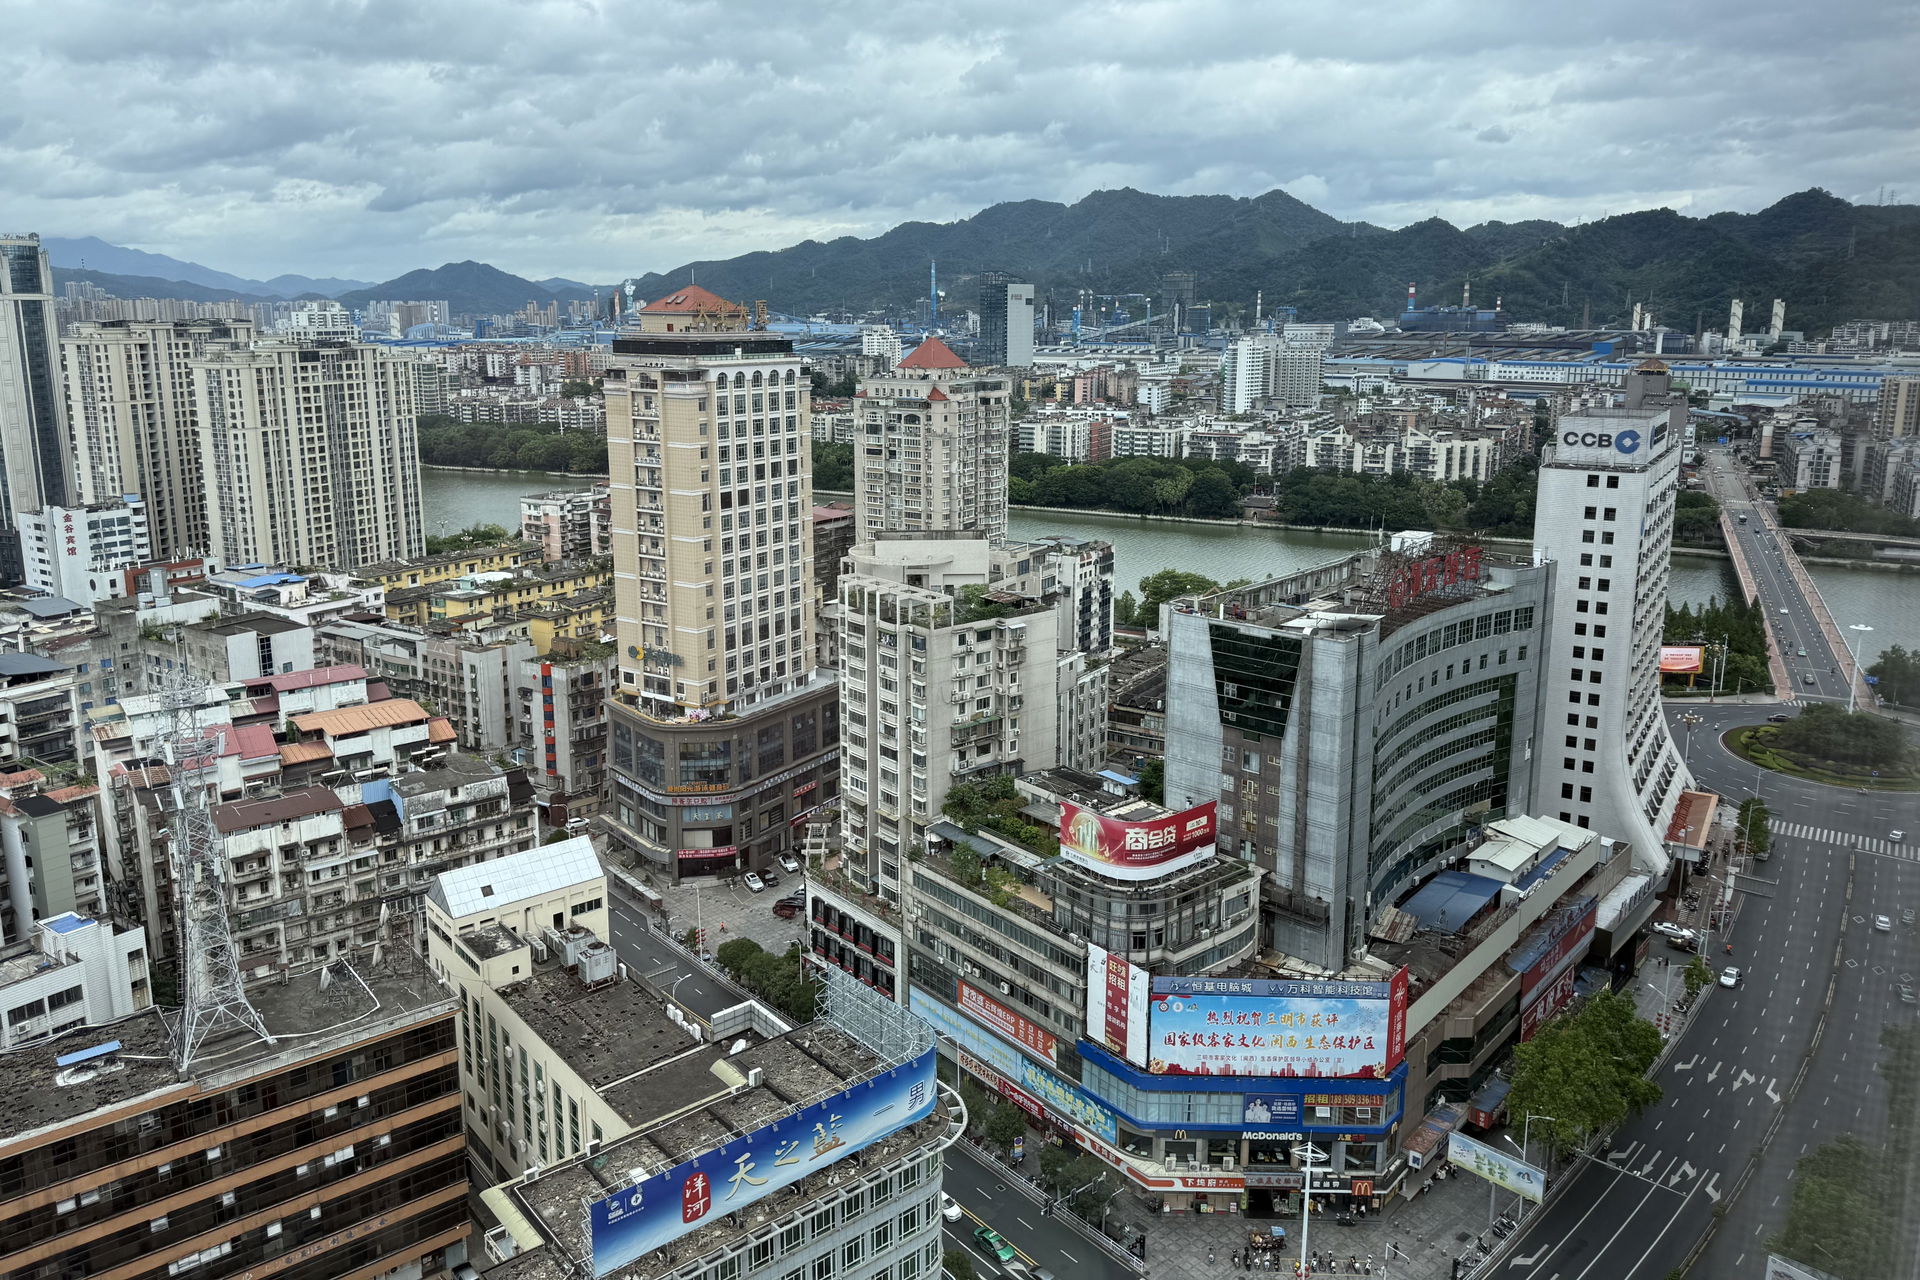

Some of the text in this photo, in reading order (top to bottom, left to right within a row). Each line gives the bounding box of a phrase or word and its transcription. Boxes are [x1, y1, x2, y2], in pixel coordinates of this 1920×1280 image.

[1563, 431, 1612, 448] CCB
[62, 513, 77, 556] 金谷宾馆
[1124, 825, 1176, 851] 商会贷
[1109, 972, 1126, 990] 招租
[1192, 982, 1252, 993] 恒基电脑城
[1287, 984, 1373, 996] 万科智能科技馆
[1206, 1010, 1339, 1027] 热烈祝贺三明市获评
[1304, 1094, 1329, 1104] 招租
[1242, 1131, 1303, 1141] McDonald's
[685, 1174, 709, 1219] 洋河
